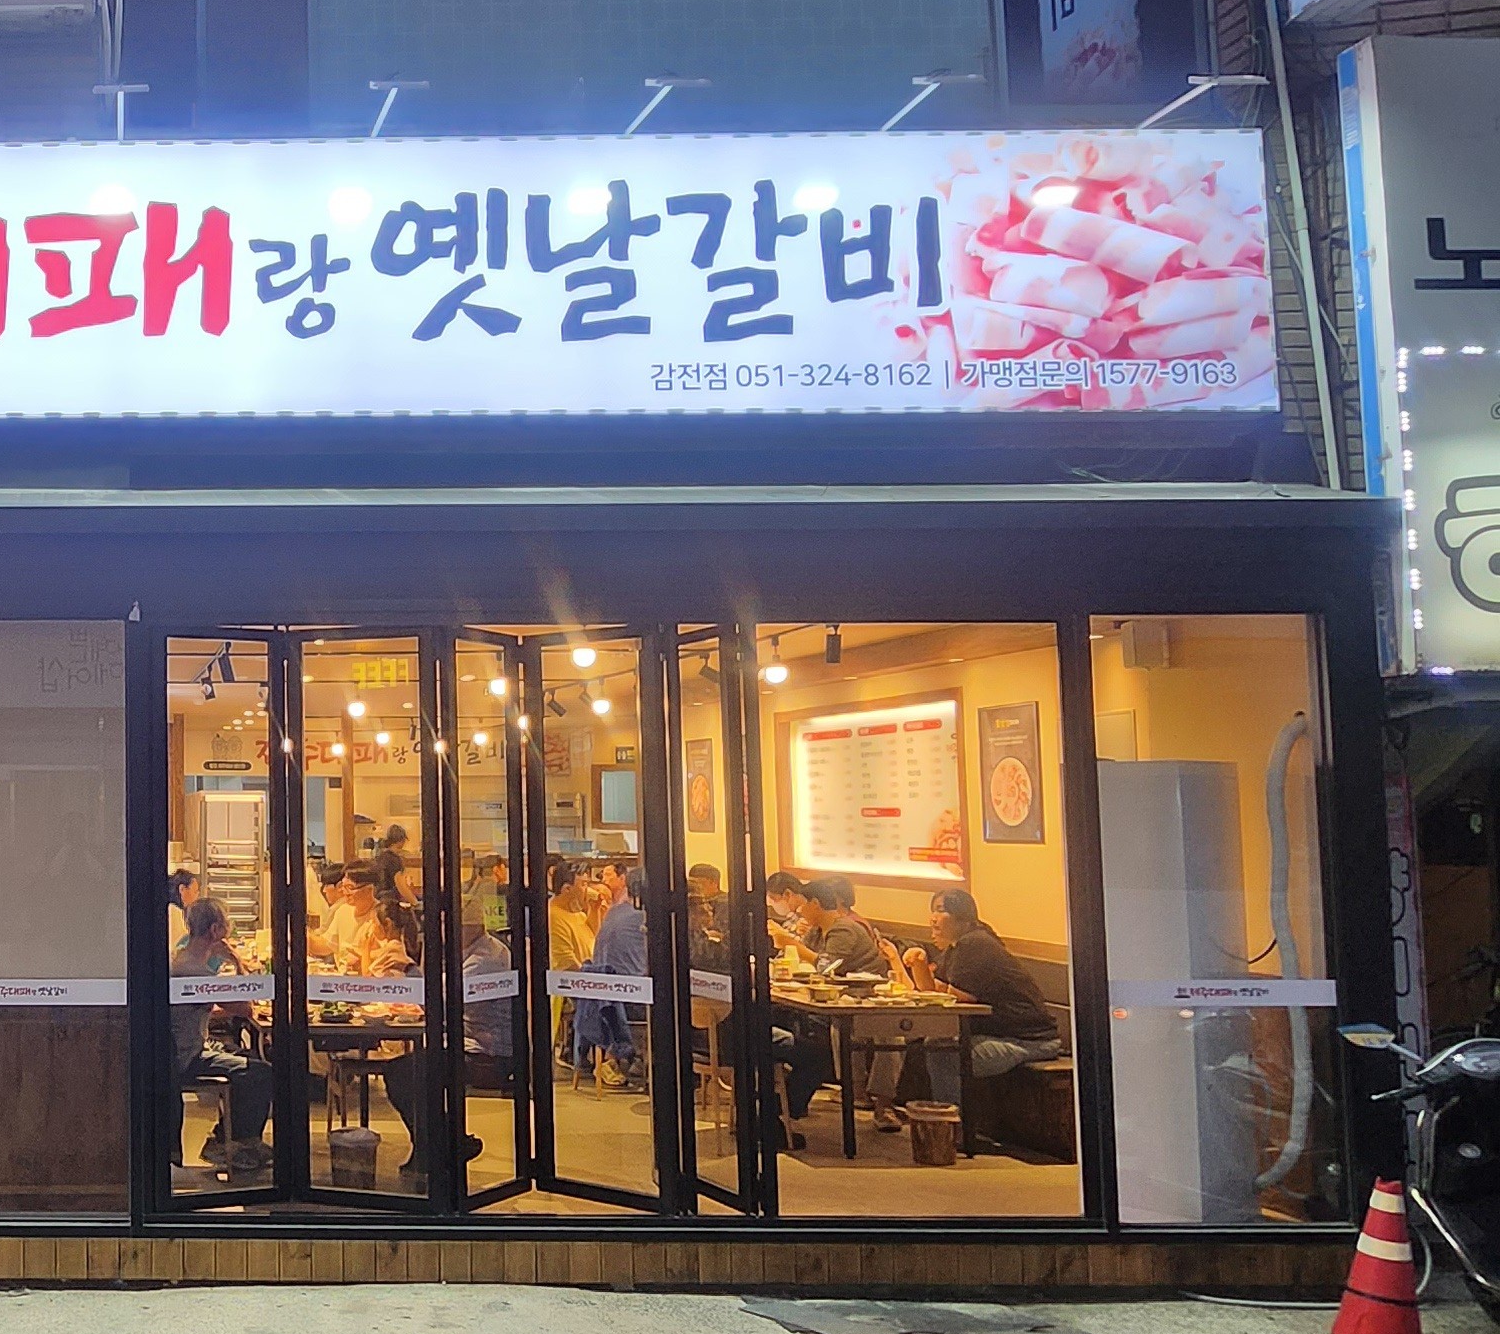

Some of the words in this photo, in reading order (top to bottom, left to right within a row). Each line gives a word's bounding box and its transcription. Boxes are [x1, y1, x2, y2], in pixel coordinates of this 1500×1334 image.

[371, 179, 948, 343] 옛날갈비
[650, 362, 729, 393] 감전점
[735, 362, 932, 388] 051-324-8162
[963, 359, 1090, 389] 가맹점문의
[1095, 359, 1239, 386] 1577-9163
